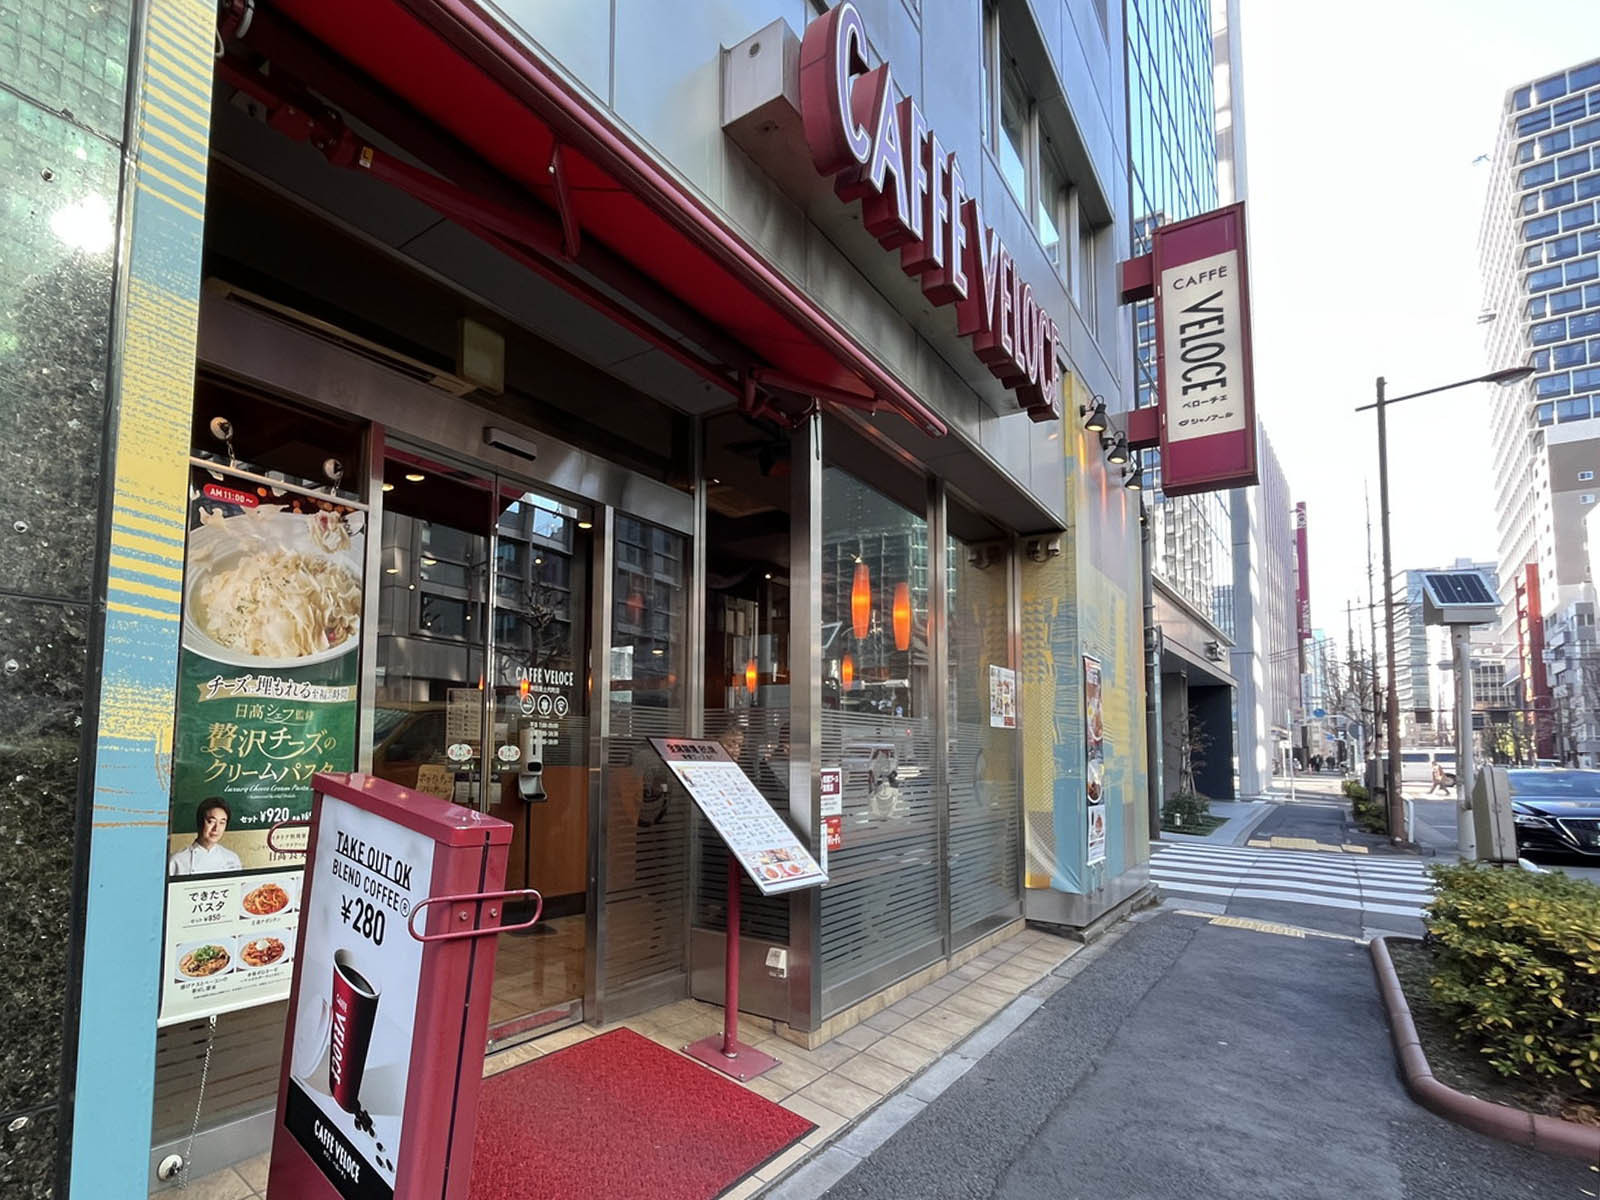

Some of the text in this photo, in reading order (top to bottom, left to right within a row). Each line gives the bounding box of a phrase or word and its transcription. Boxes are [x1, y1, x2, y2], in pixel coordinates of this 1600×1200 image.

[1179, 289, 1228, 396] VELOCE
[544, 668, 574, 686] VELOCE
[202, 722, 337, 759] 贅沢チーズの
[260, 807, 289, 823] ¥920
[332, 858, 361, 888] BLEND
[335, 830, 413, 892] TAKE OUT OK
[188, 889, 230, 902] できたて
[191, 900, 225, 914] パスタ
[340, 894, 386, 946] ¥280
[335, 1140, 361, 1184] VELOCE
